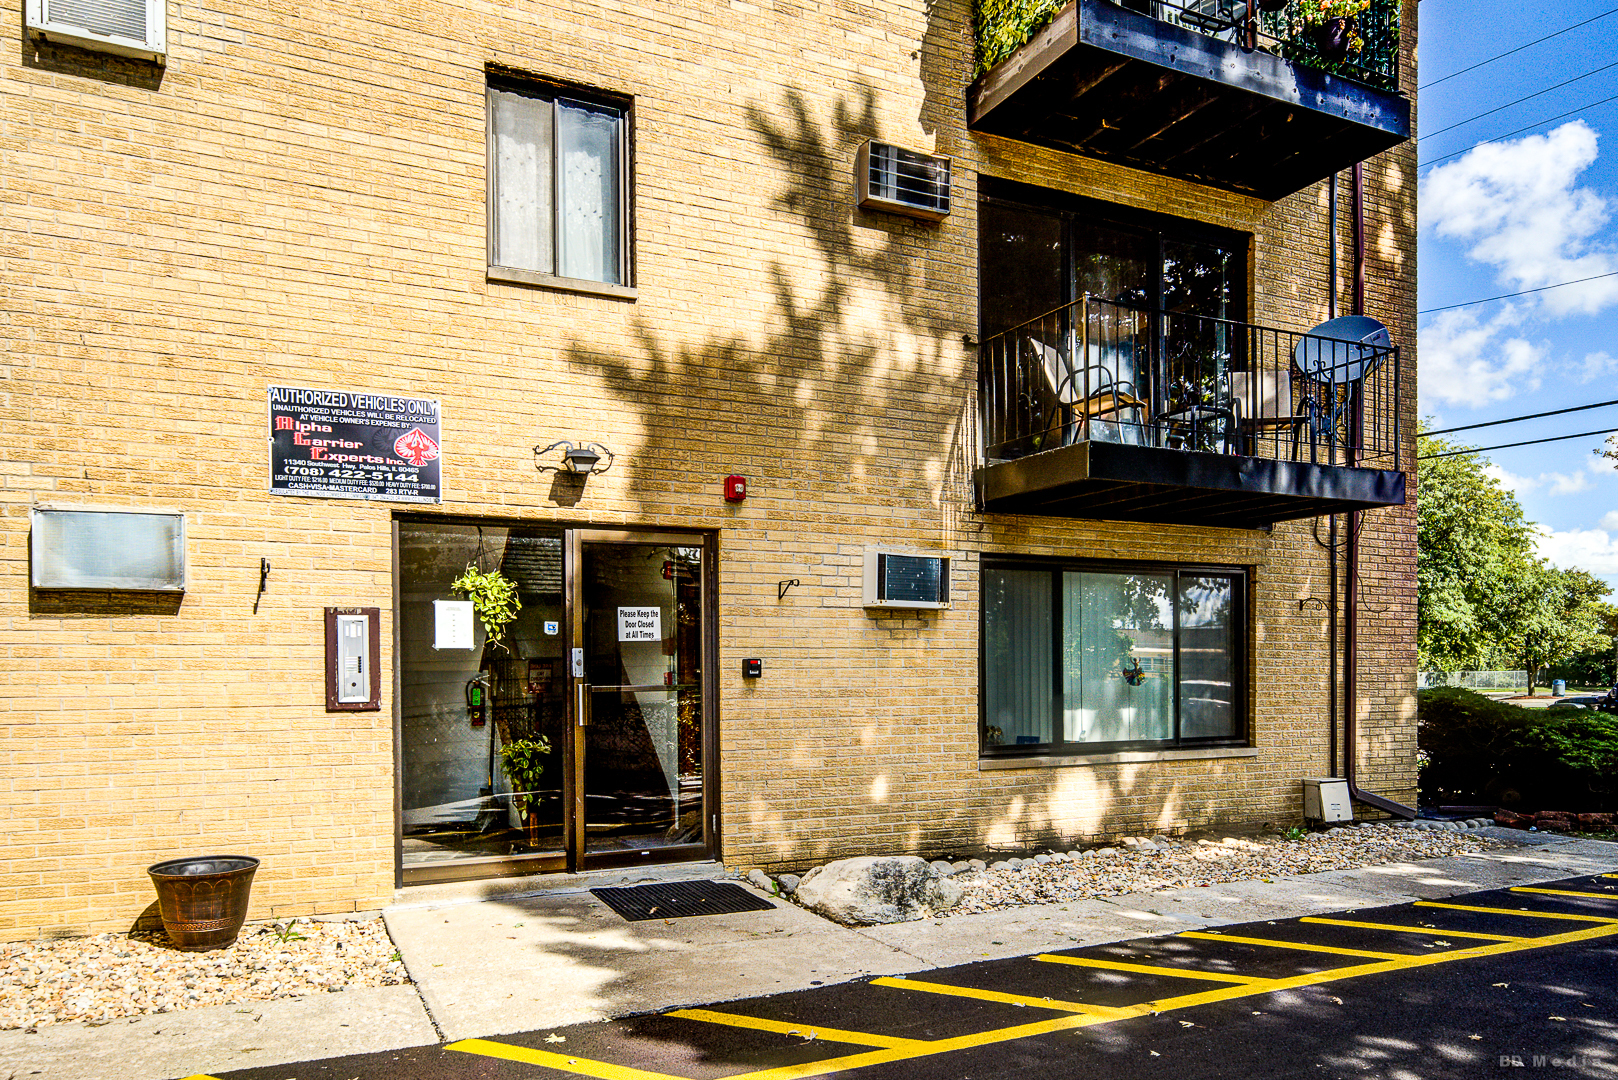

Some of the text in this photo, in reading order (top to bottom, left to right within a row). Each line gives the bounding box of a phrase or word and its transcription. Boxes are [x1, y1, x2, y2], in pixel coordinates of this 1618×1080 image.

[272, 387, 436, 416] AUTHORIZED VEHICLES ONLY
[273, 404, 330, 414] UNAUTHORIZED
[331, 408, 366, 417] VEHICLES
[396, 414, 436, 424] RELOCATED
[275, 415, 332, 432] Alpha
[339, 417, 370, 425] OWNER'S
[371, 420, 400, 428] EXPENSE
[310, 446, 384, 464] Experts
[307, 460, 340, 468] Southwest
[284, 466, 419, 482] (708) 422-5144
[637, 610, 650, 619] Keep
[625, 620, 654, 628] Door Closed
